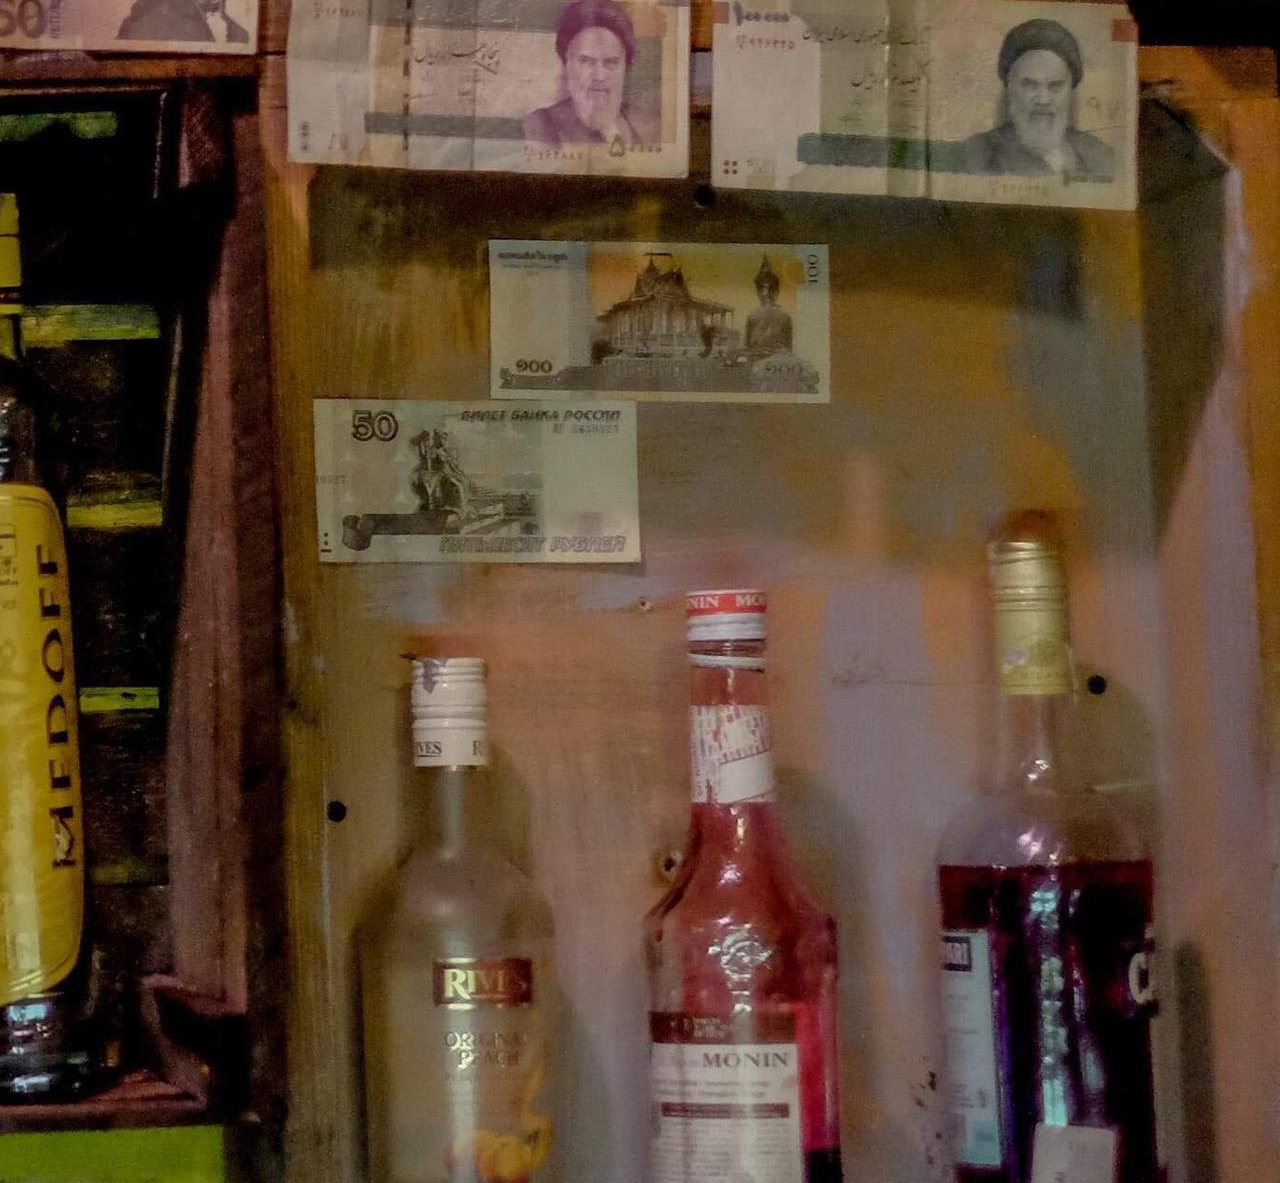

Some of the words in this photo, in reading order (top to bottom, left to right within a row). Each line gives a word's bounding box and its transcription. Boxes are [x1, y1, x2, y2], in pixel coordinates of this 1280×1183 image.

[510, 408, 560, 423] БАНКА
[562, 408, 622, 423] РОССИИ
[351, 408, 399, 442] 50
[702, 1052, 789, 1069] MONIN
